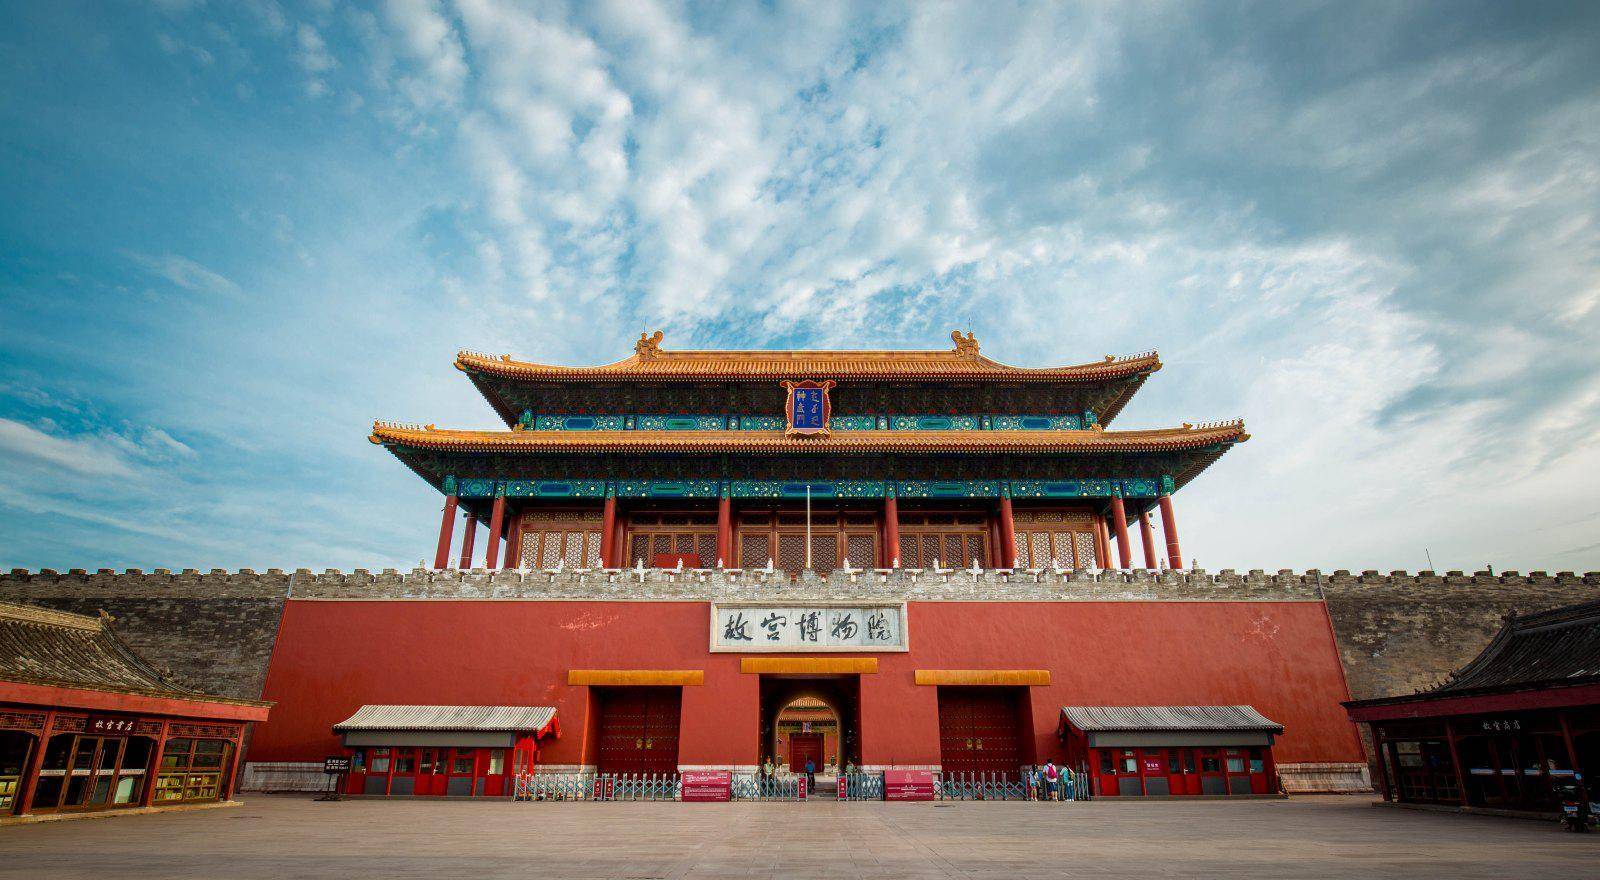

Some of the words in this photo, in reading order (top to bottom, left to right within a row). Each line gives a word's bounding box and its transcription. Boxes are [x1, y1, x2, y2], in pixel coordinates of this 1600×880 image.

[724, 611, 892, 642] 故宫博物院
